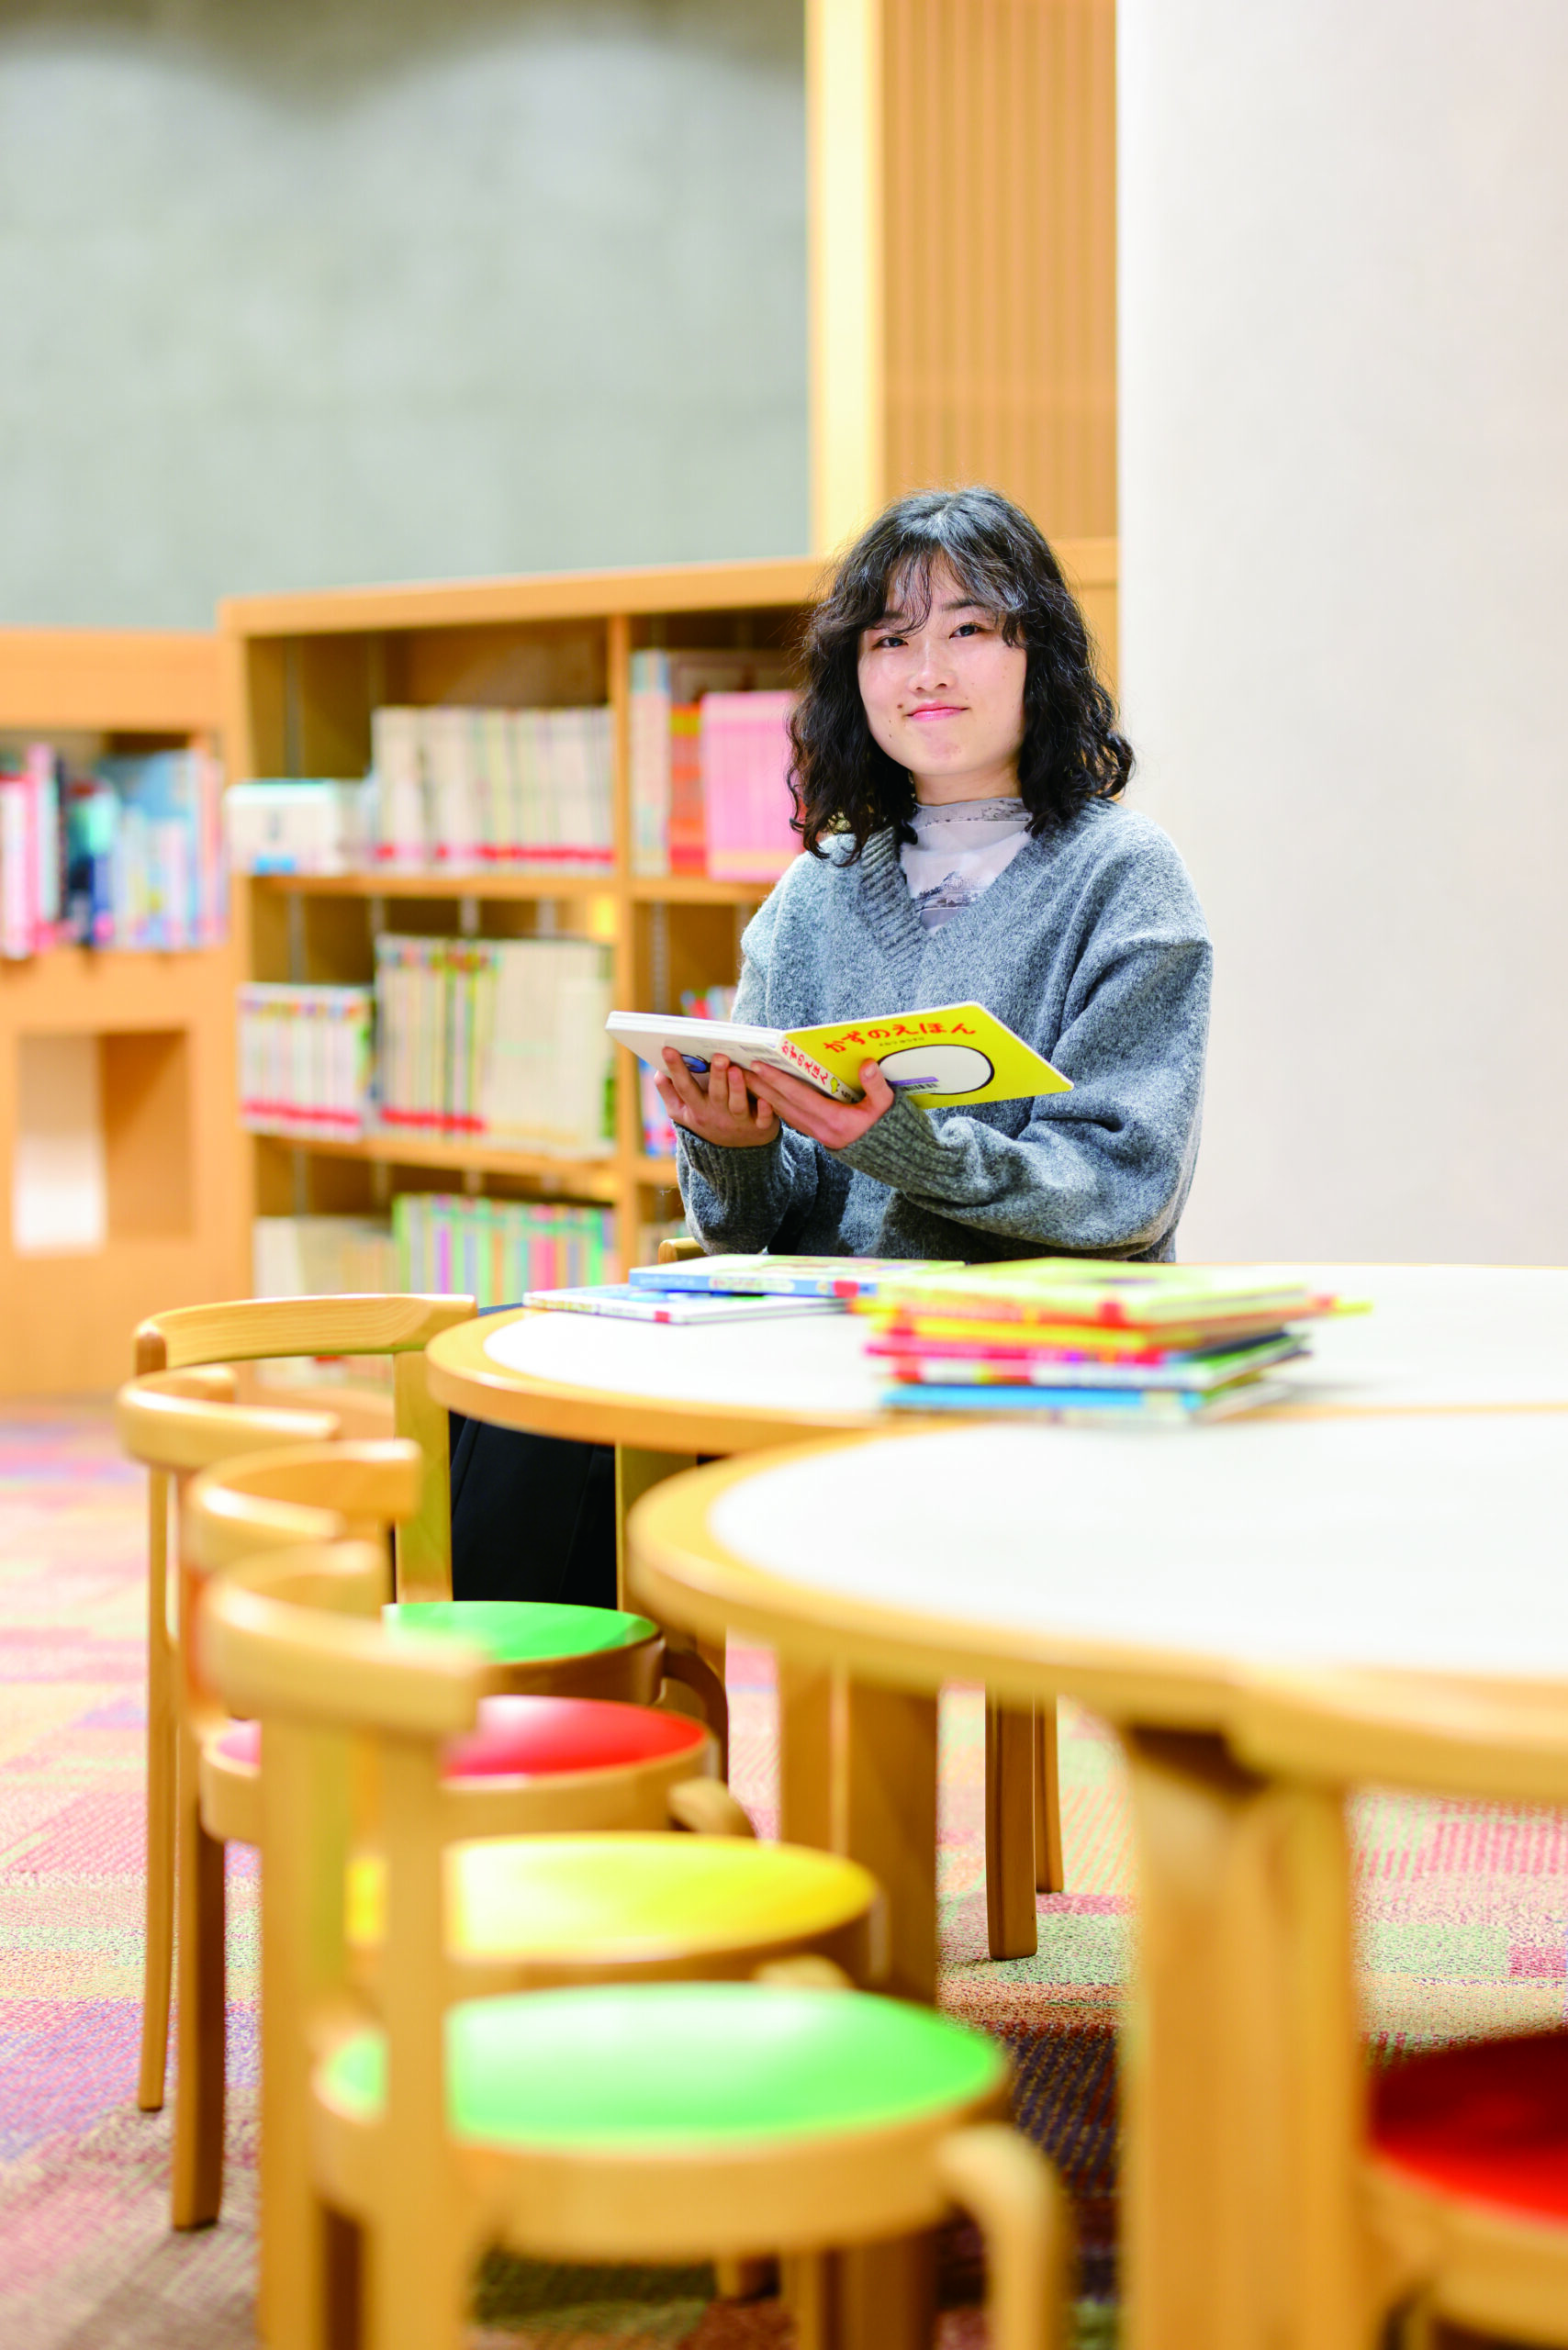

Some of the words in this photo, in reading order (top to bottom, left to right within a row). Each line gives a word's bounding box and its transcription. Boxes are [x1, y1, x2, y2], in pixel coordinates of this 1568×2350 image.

[823, 1023, 976, 1053] かずのえほん
[781, 1040, 829, 1085] かずのえほん
